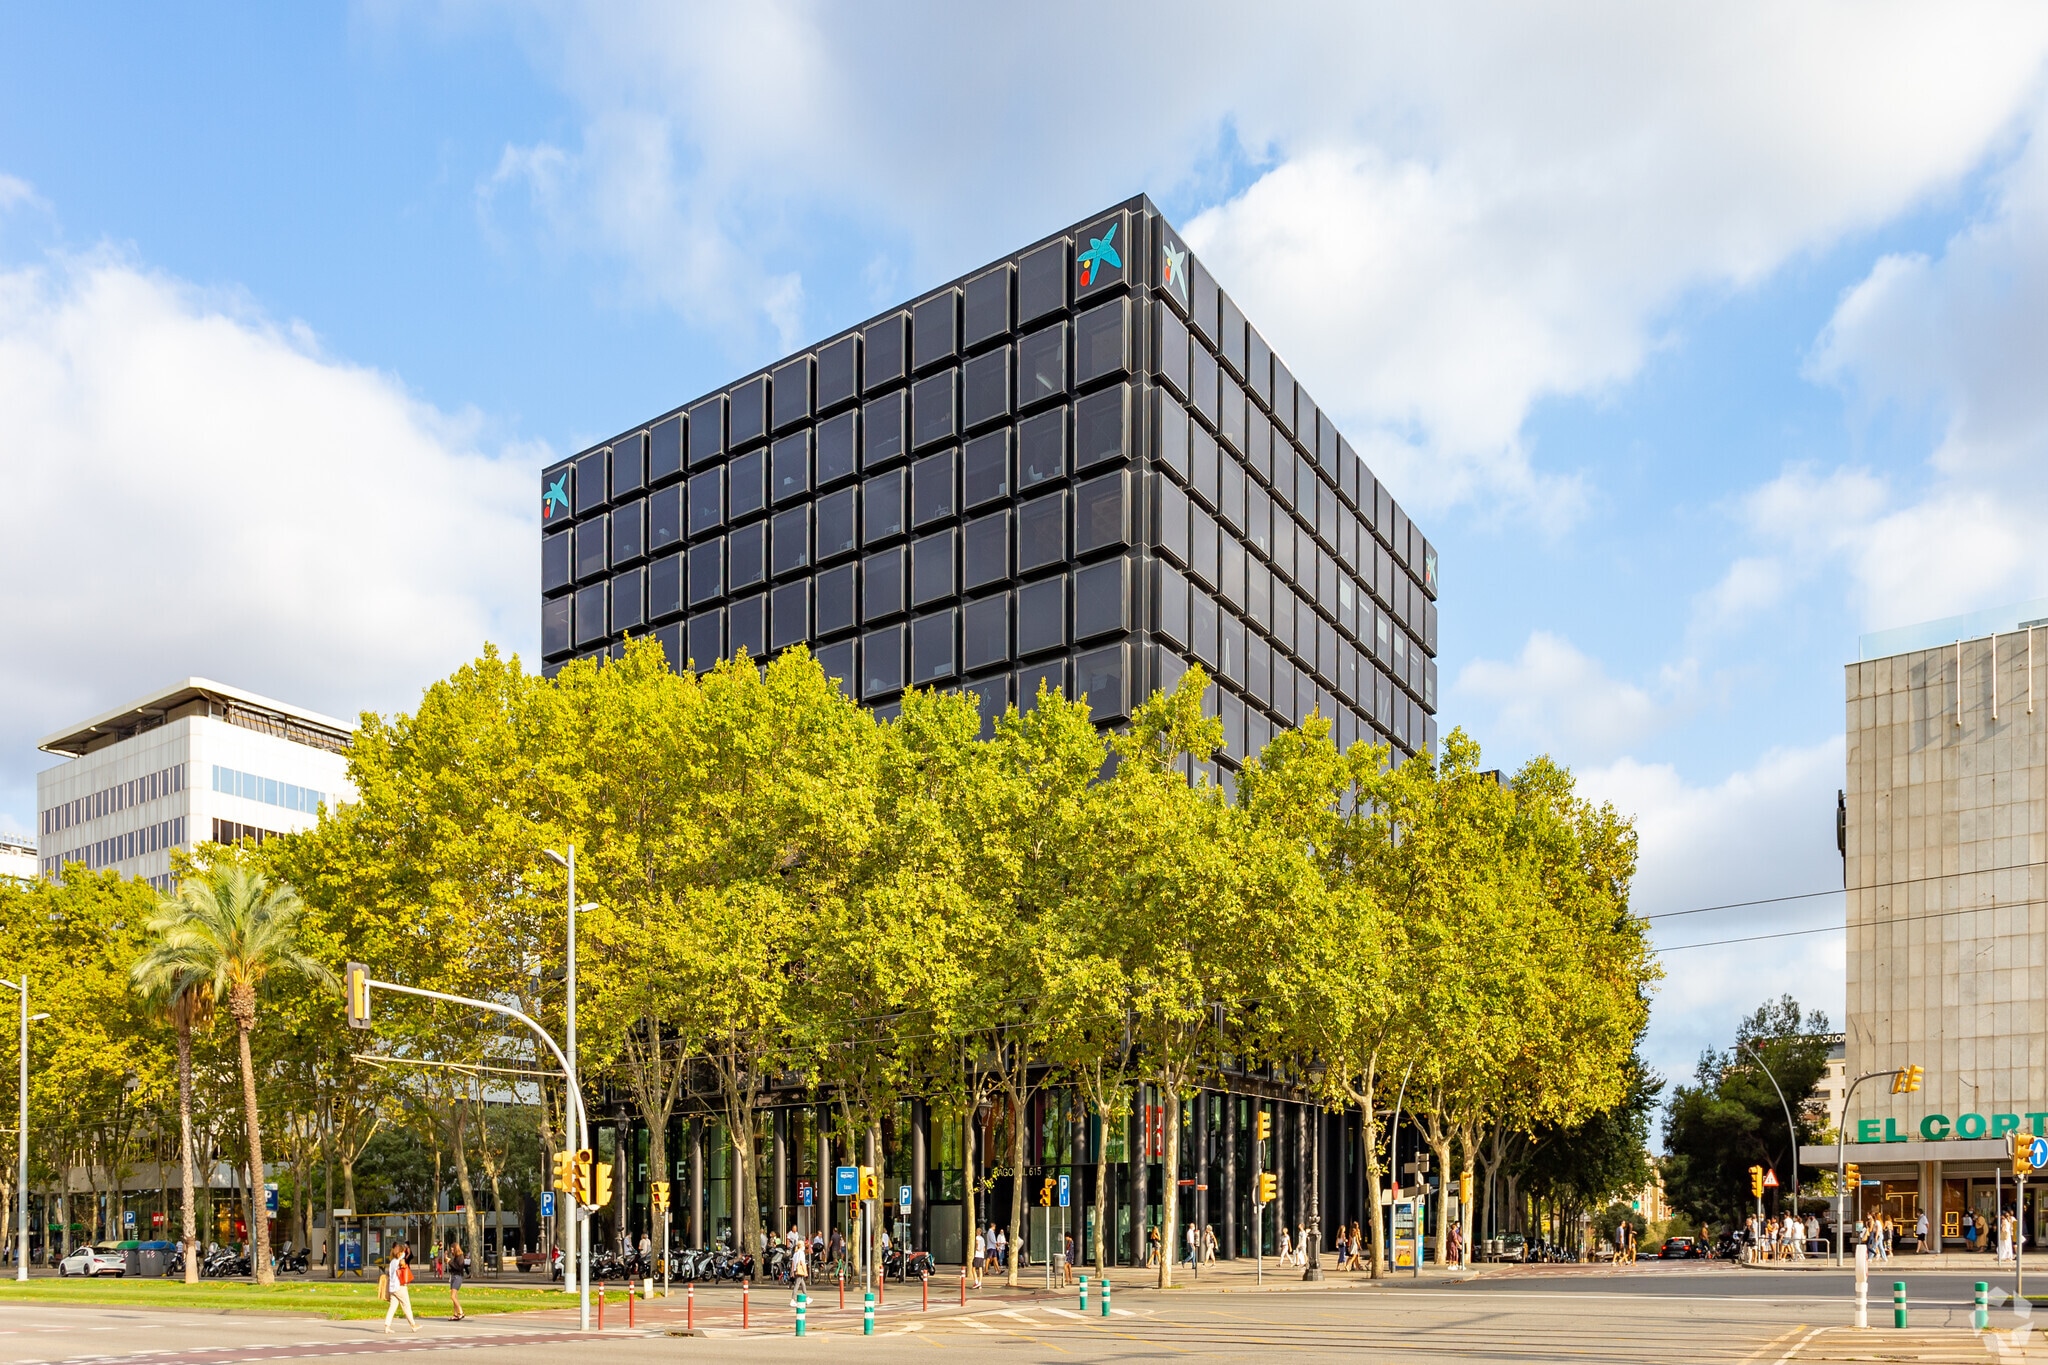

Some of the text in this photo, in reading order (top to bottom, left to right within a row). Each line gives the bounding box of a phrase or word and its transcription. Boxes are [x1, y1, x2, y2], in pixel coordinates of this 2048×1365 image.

[1857, 1112, 2048, 1143] EL CORT
[1029, 1166, 1042, 1177] 615
[1061, 1178, 1067, 1194] P
[543, 1193, 552, 1207] P
[902, 1189, 909, 1204] P
[126, 1212, 133, 1222] P
